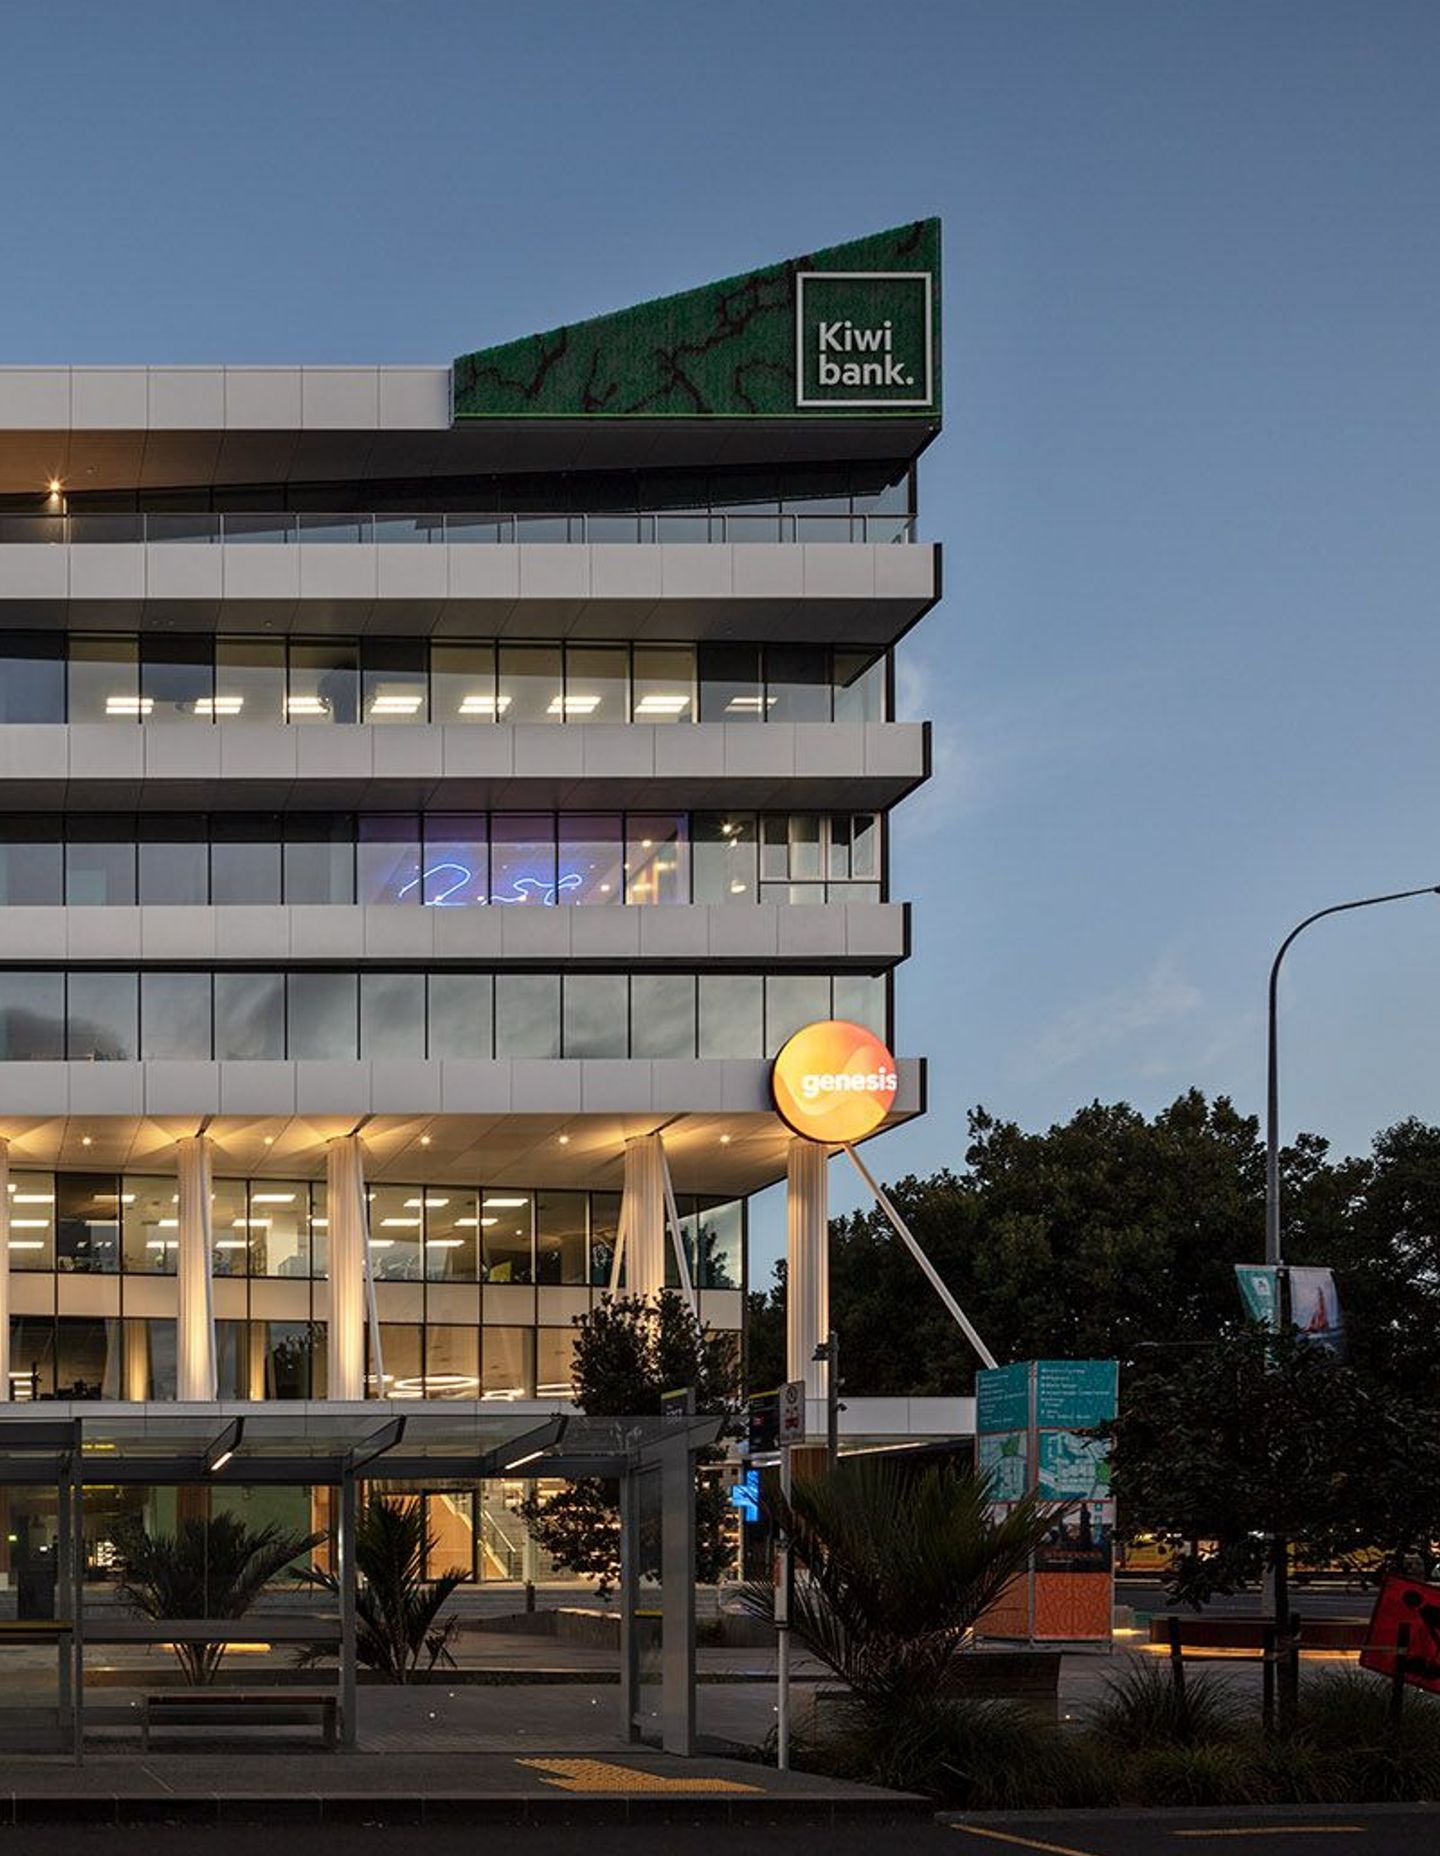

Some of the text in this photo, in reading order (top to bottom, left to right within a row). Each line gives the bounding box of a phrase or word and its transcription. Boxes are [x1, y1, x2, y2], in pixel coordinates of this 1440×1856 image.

[818, 320, 893, 352] Kiwi
[818, 354, 914, 386] bank.
[802, 1066, 898, 1097] genesis
